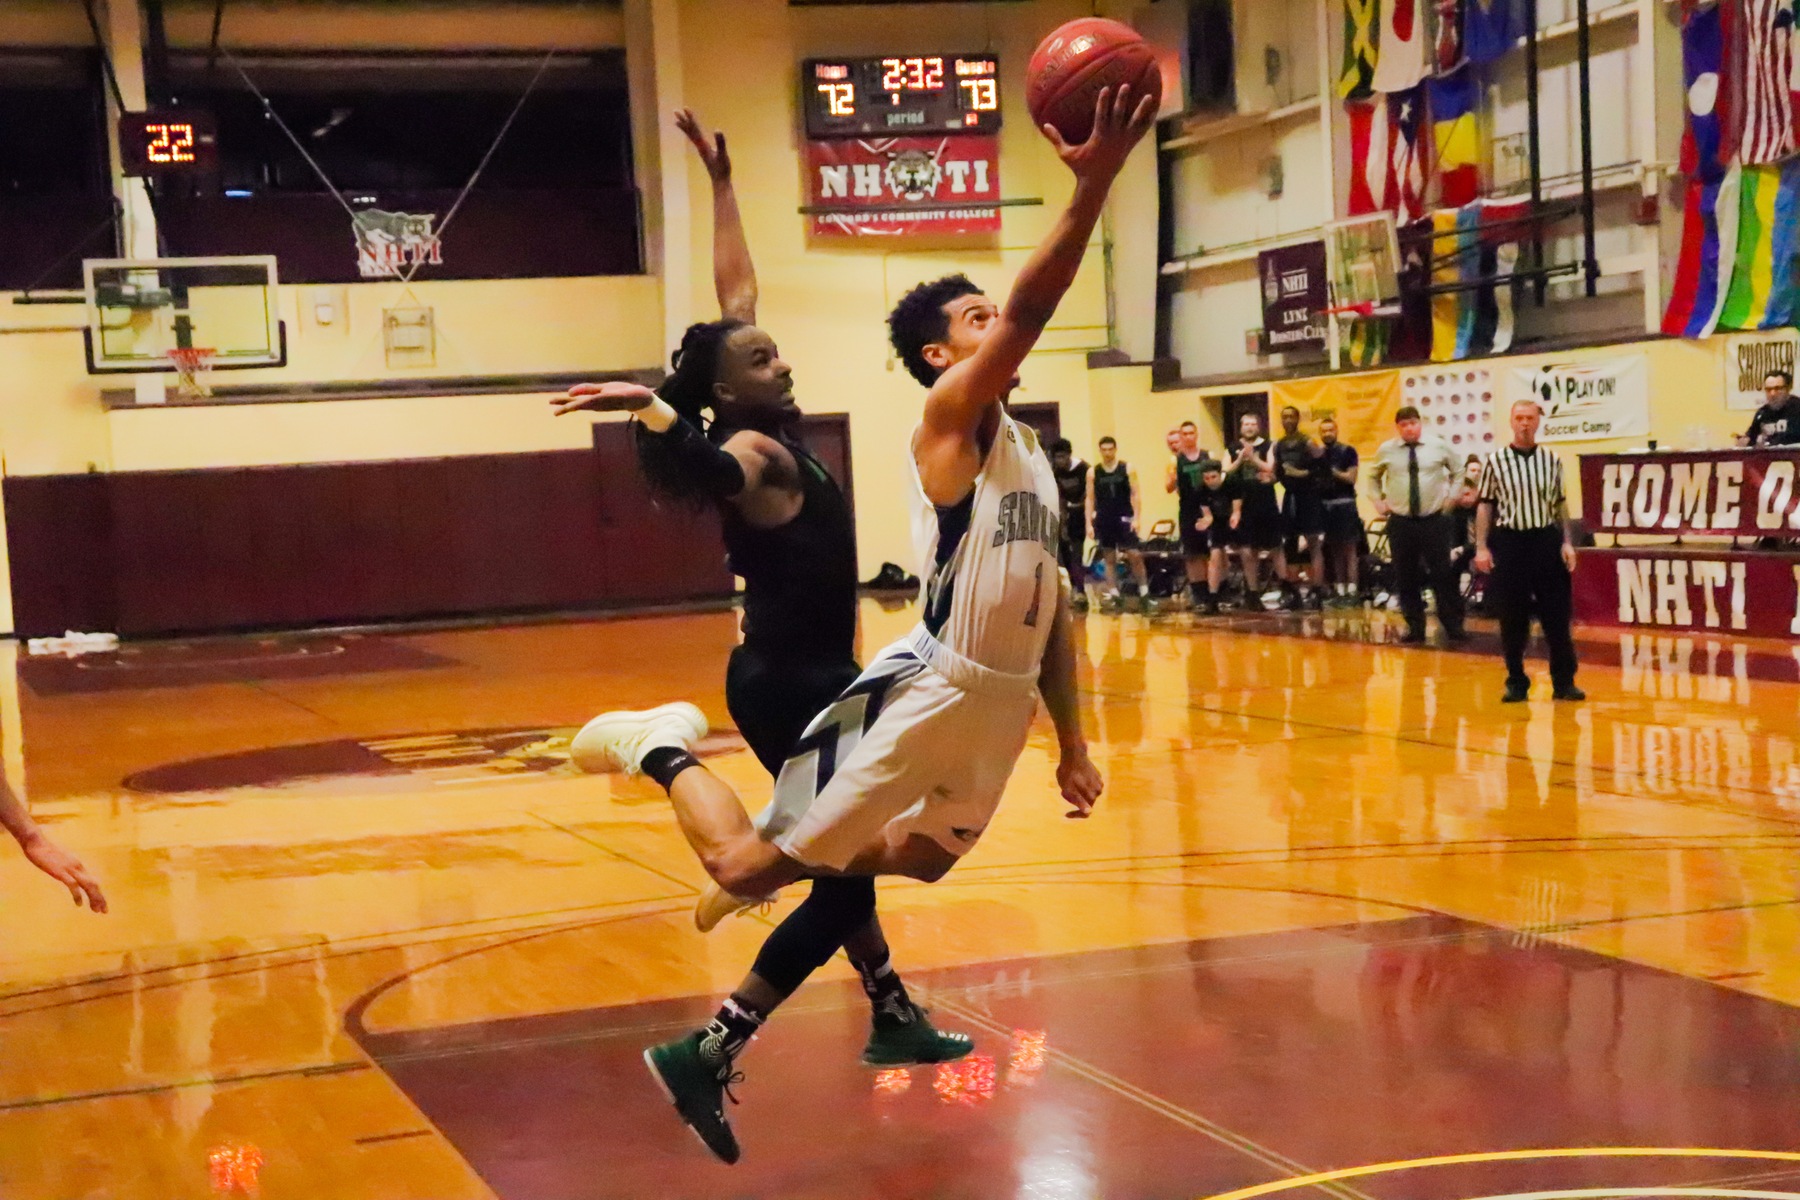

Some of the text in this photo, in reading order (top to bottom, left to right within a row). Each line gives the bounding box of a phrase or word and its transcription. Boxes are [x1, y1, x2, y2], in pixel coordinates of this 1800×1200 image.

[882, 58, 944, 89] 2:32
[818, 83, 855, 115] 72
[960, 79, 997, 110] 73
[887, 111, 924, 127] period
[146, 124, 194, 161] 22
[881, 210, 946, 222] COMMUNITY
[949, 209, 995, 220] COLLEGE
[1544, 421, 1612, 436] Soccer Camp
[1601, 461, 1800, 529] HOME O
[1024, 562, 1043, 627] 1
[1617, 559, 1747, 629] NHTI
